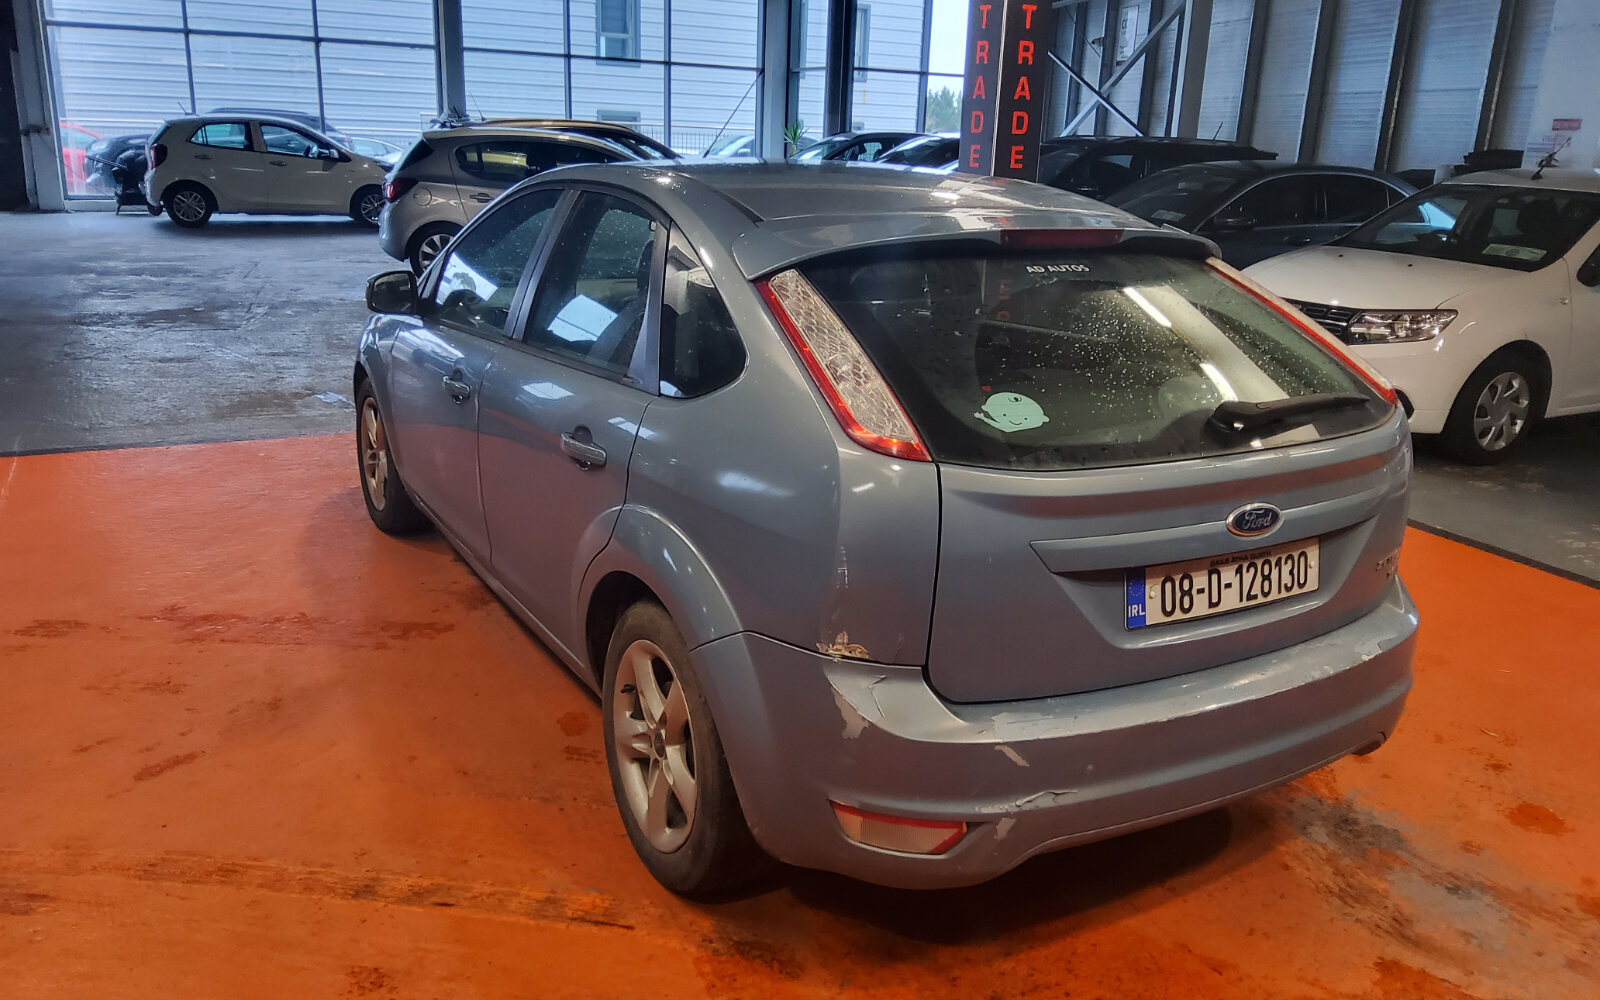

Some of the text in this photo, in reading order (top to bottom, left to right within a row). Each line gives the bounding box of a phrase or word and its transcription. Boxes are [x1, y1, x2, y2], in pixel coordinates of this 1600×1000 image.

[969, 4, 992, 168] TRADE
[1009, 4, 1037, 169] TRADE
[1026, 264, 1090, 274] AD AUTOS
[1242, 509, 1273, 530] Ford
[1160, 550, 1309, 618] 08-D-128130
[1128, 603, 1146, 618] IRL
